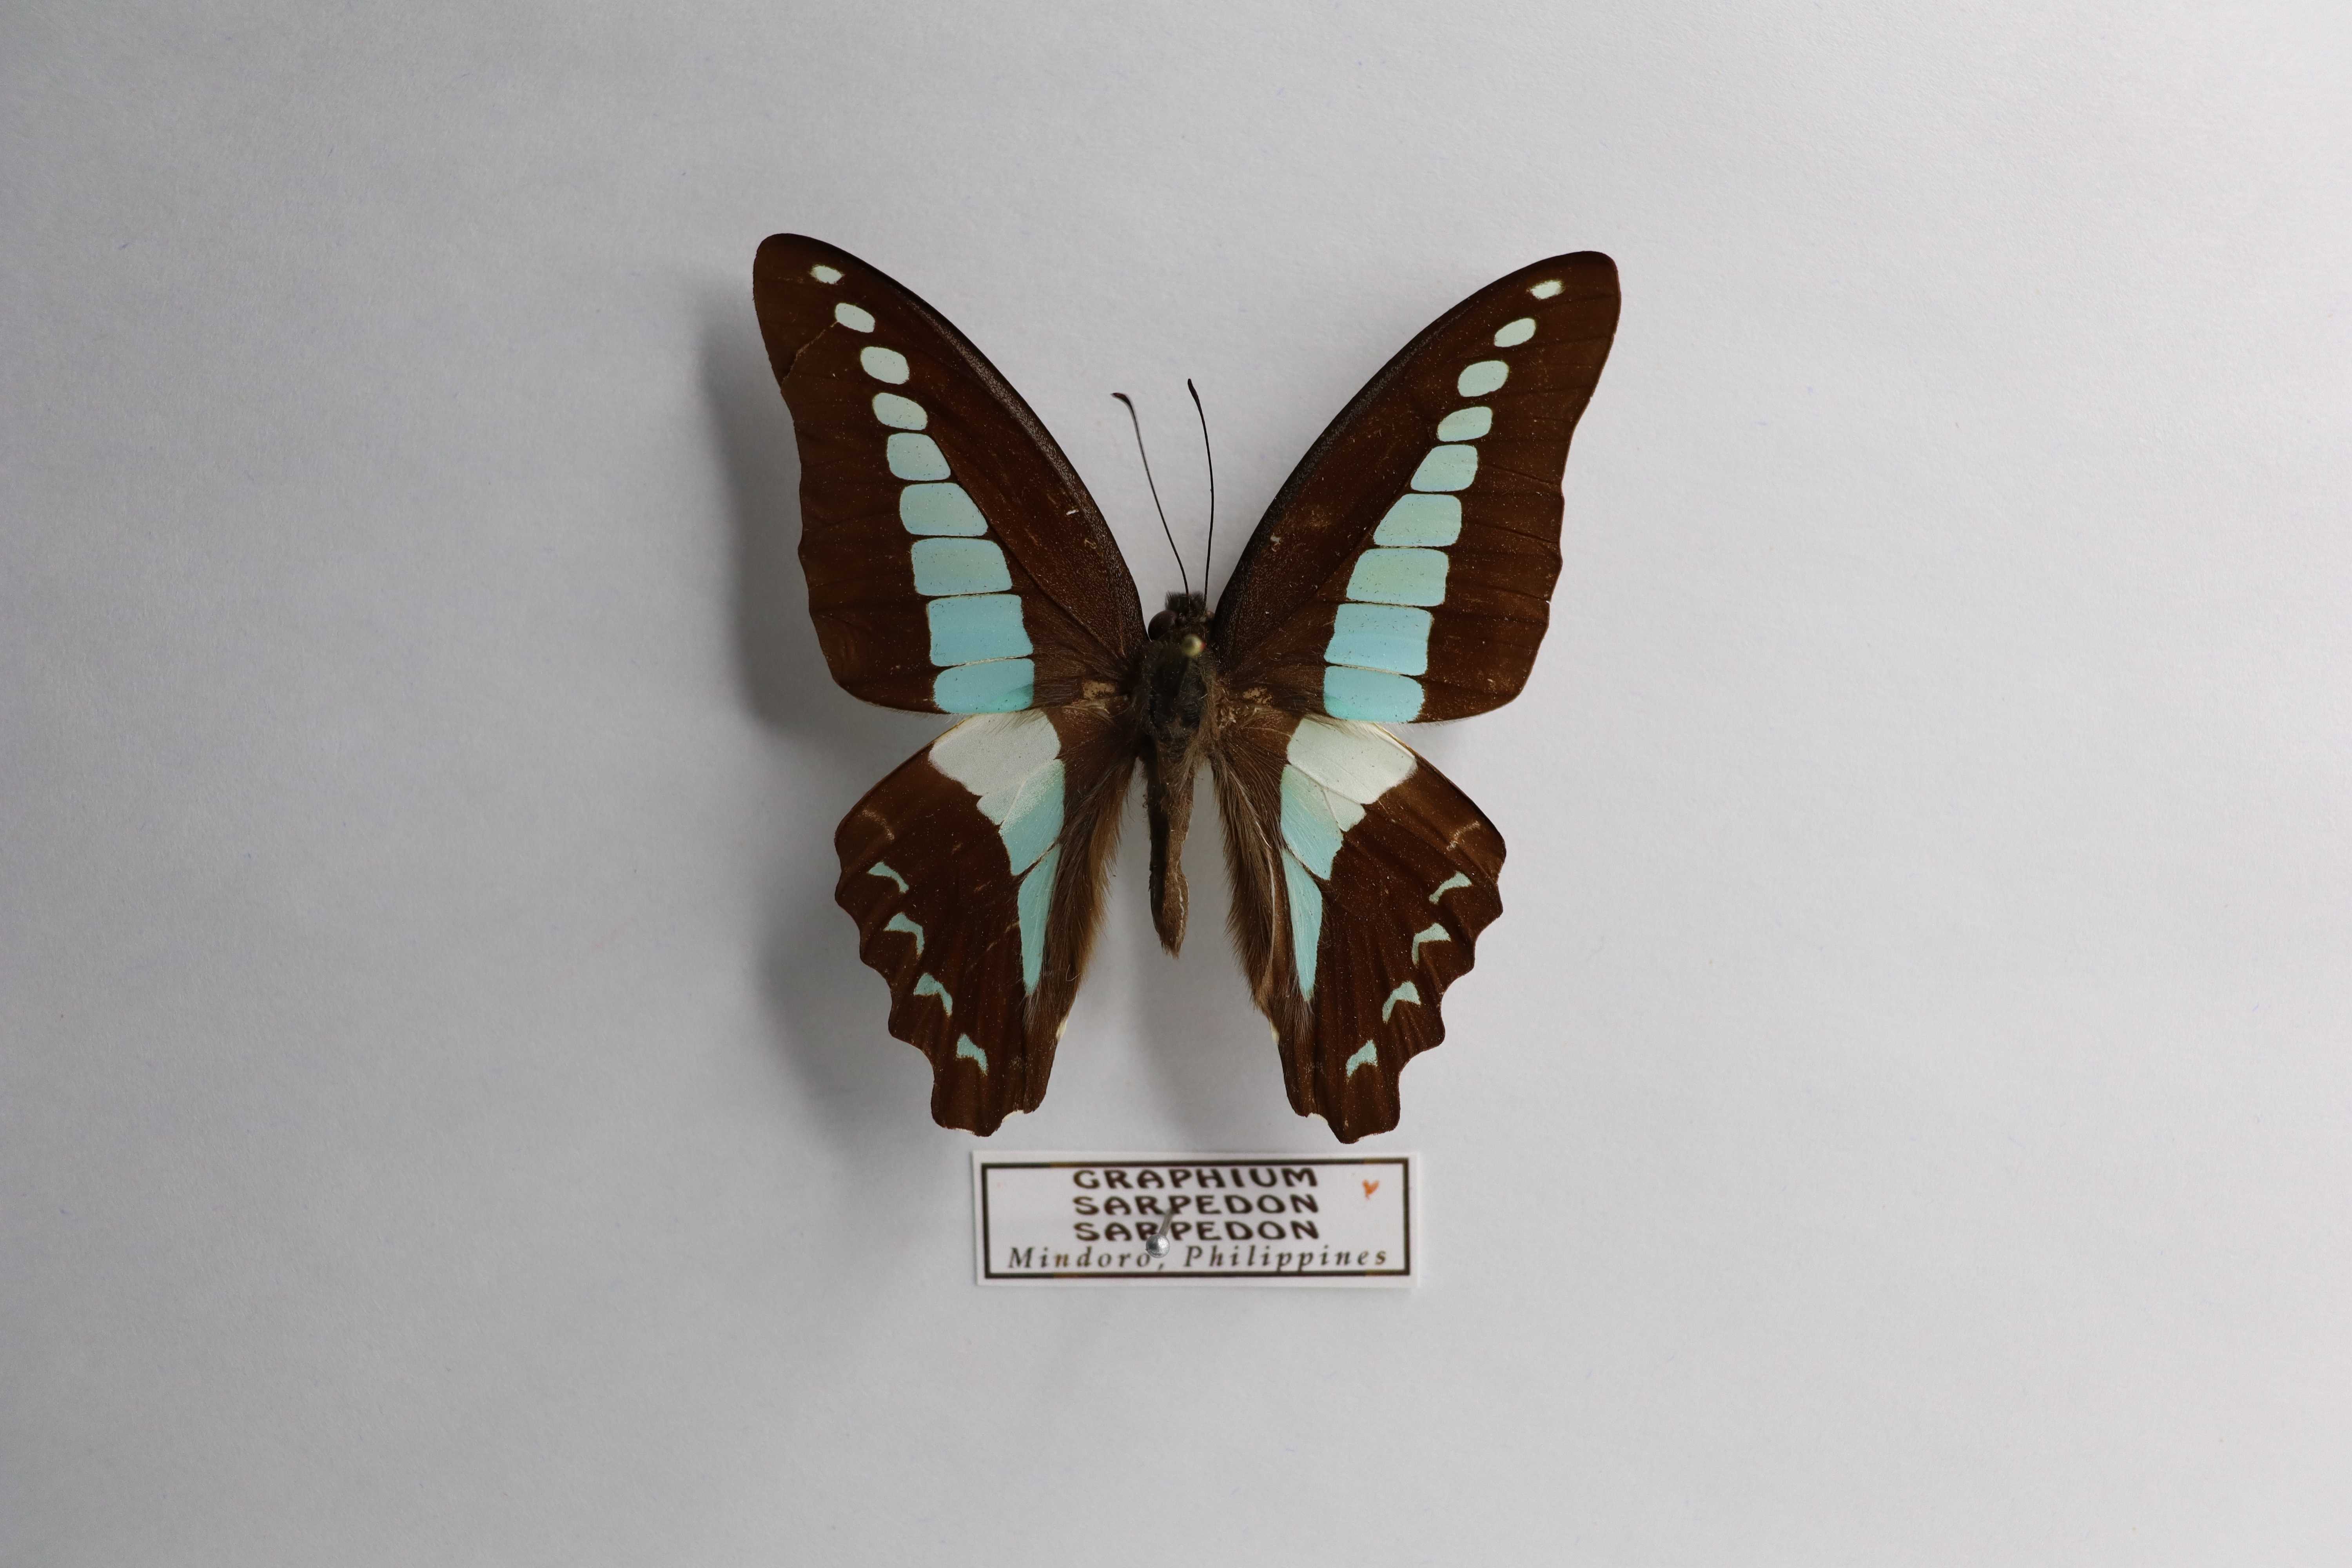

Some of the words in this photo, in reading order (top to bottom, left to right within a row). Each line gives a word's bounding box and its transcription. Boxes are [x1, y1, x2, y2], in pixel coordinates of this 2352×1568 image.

[1073, 1168, 1318, 1189] GRAPHIUM
[1073, 1194, 1319, 1215] SARPEDON
[1073, 1221, 1319, 1241] SARPEDON
[1008, 1246, 1164, 1270] Mindoro,
[1184, 1245, 1387, 1272] Philippines
